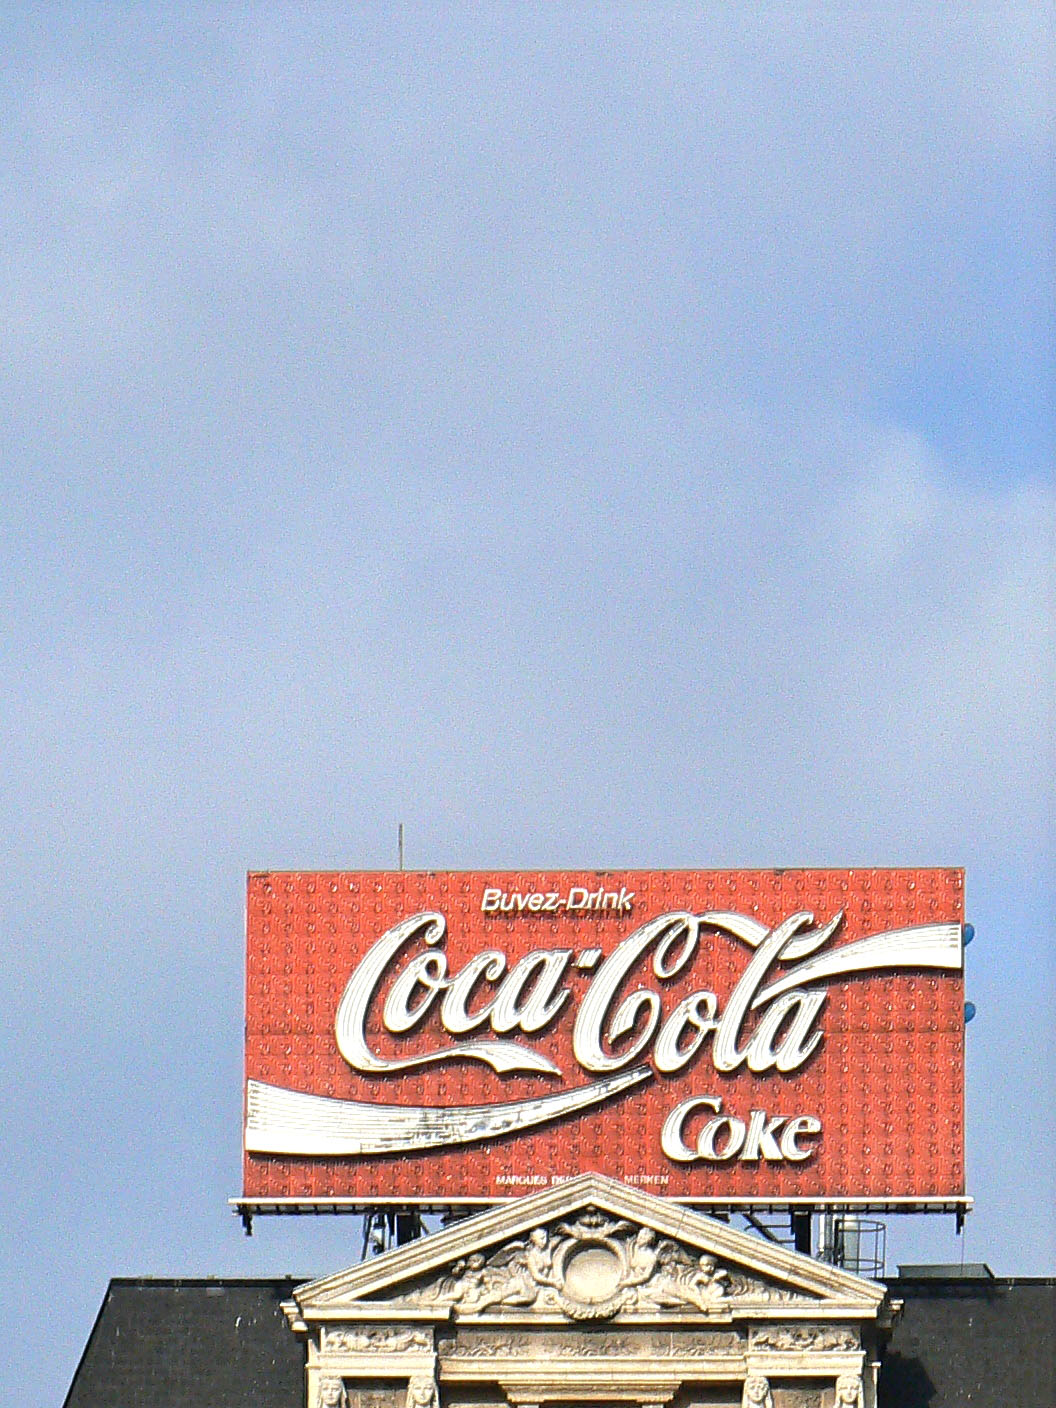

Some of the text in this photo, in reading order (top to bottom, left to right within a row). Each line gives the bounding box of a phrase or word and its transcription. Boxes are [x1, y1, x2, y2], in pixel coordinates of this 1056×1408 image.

[481, 887, 634, 911] Buvez-Drink
[335, 908, 841, 1076] Coca-Cola
[661, 1094, 822, 1162] Coke
